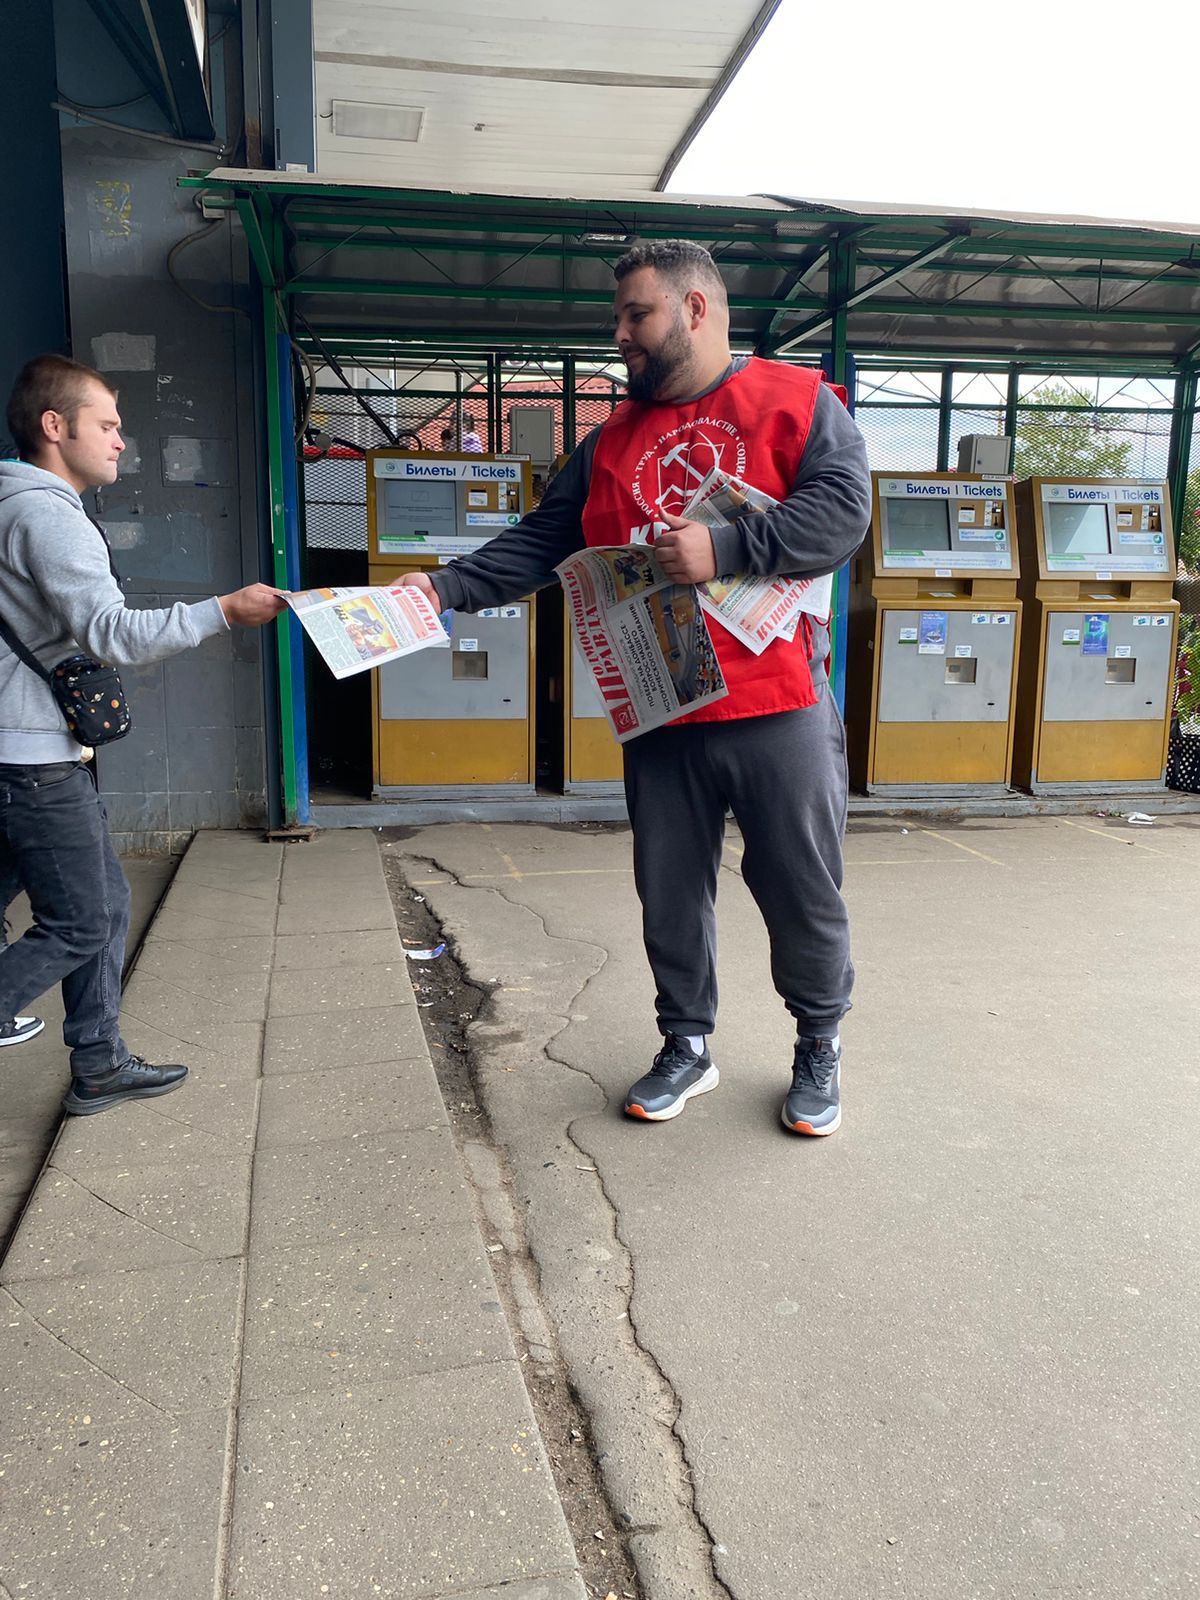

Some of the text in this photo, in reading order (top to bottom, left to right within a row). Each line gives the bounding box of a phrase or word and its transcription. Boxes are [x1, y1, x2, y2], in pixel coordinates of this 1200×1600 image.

[658, 416, 738, 444] НАРОДОВЛАСТИЕ
[406, 464, 456, 476] Билеты
[471, 466, 516, 478] Tickets
[635, 450, 655, 472] ТРУД
[632, 481, 654, 516] РОССИЯ
[906, 484, 950, 495] Билеты
[963, 485, 1002, 496] Tickets
[1068, 489, 1109, 499] Билеты
[1122, 490, 1159, 500] Tickets
[620, 624, 640, 664] ДОНБАССЕ
[631, 630, 646, 660] НАШЕГО
[637, 665, 645, 677] НА
[642, 661, 657, 692] ВОПРОС
[647, 651, 672, 713] ИСТОРИЧЕСКОГО
[640, 677, 655, 707] ПОБЕДА
